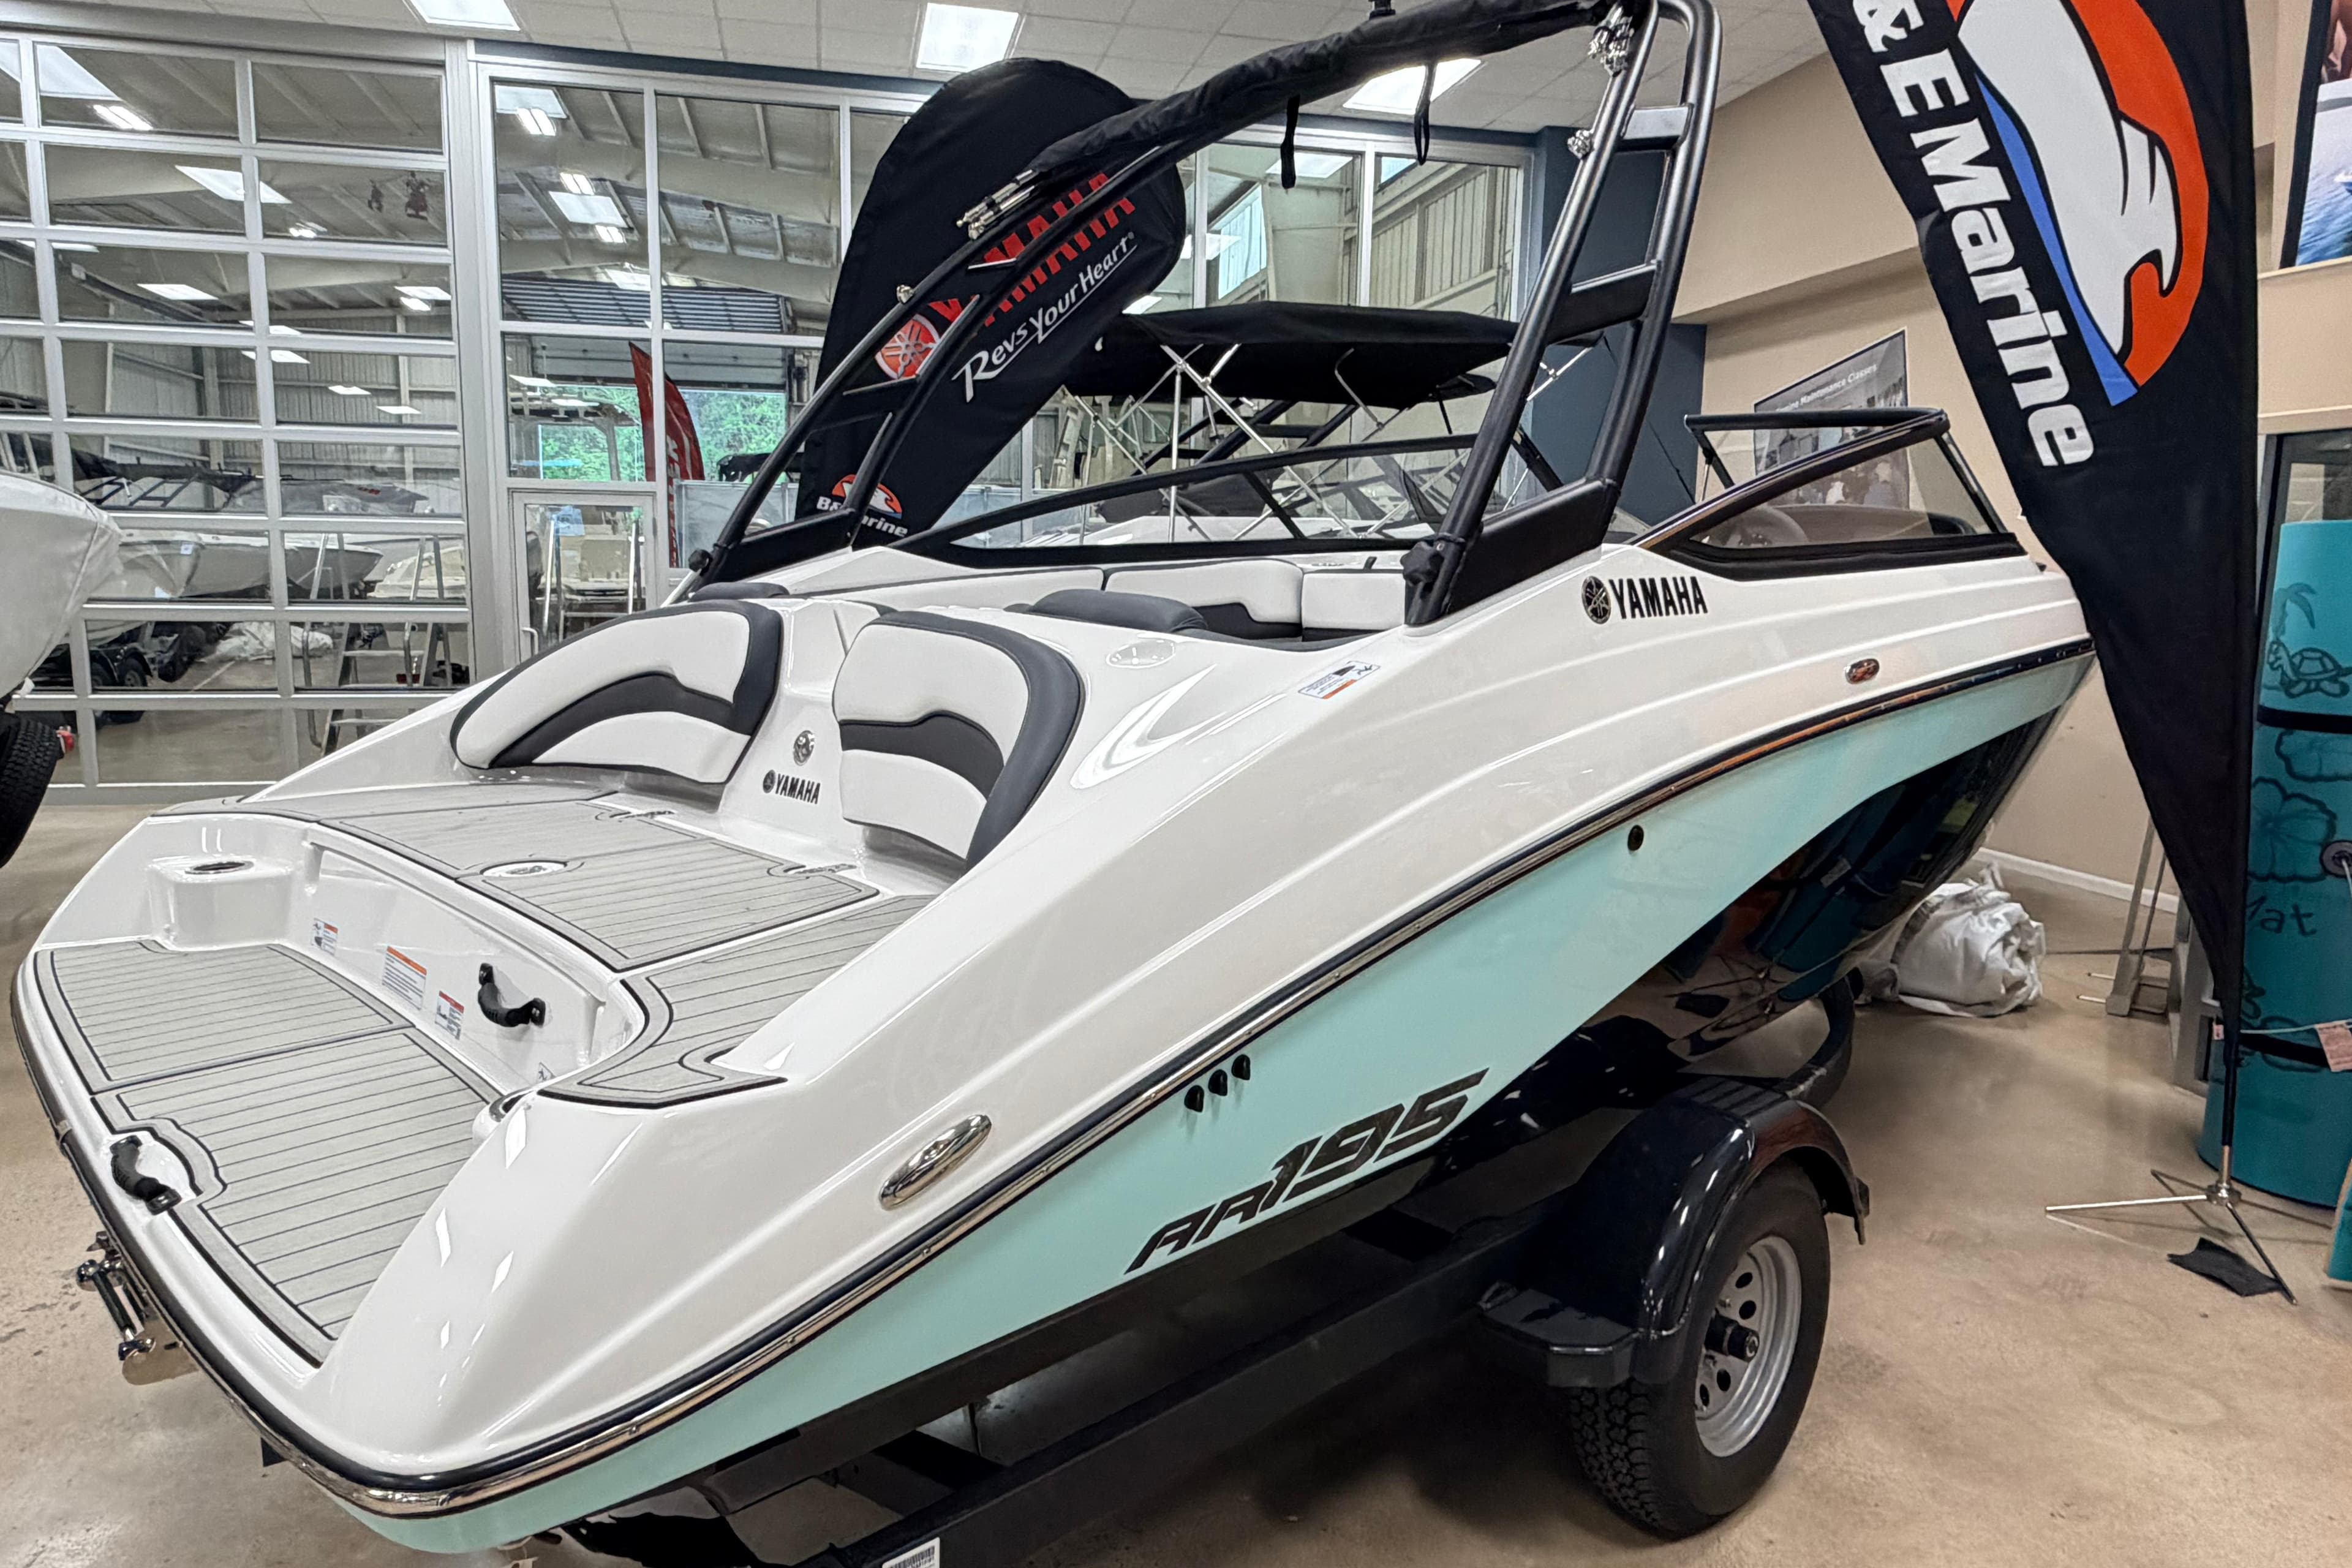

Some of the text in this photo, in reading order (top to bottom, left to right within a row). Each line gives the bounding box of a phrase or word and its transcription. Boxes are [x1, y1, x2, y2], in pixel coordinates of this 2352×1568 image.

[951, 235, 1131, 403] Revs Your Heart
[1910, 118, 2095, 467] Marine
[1608, 576, 1708, 619] YAMAHA
[775, 773, 821, 805] YAMAHA
[1123, 1067, 1490, 1275] AR195
